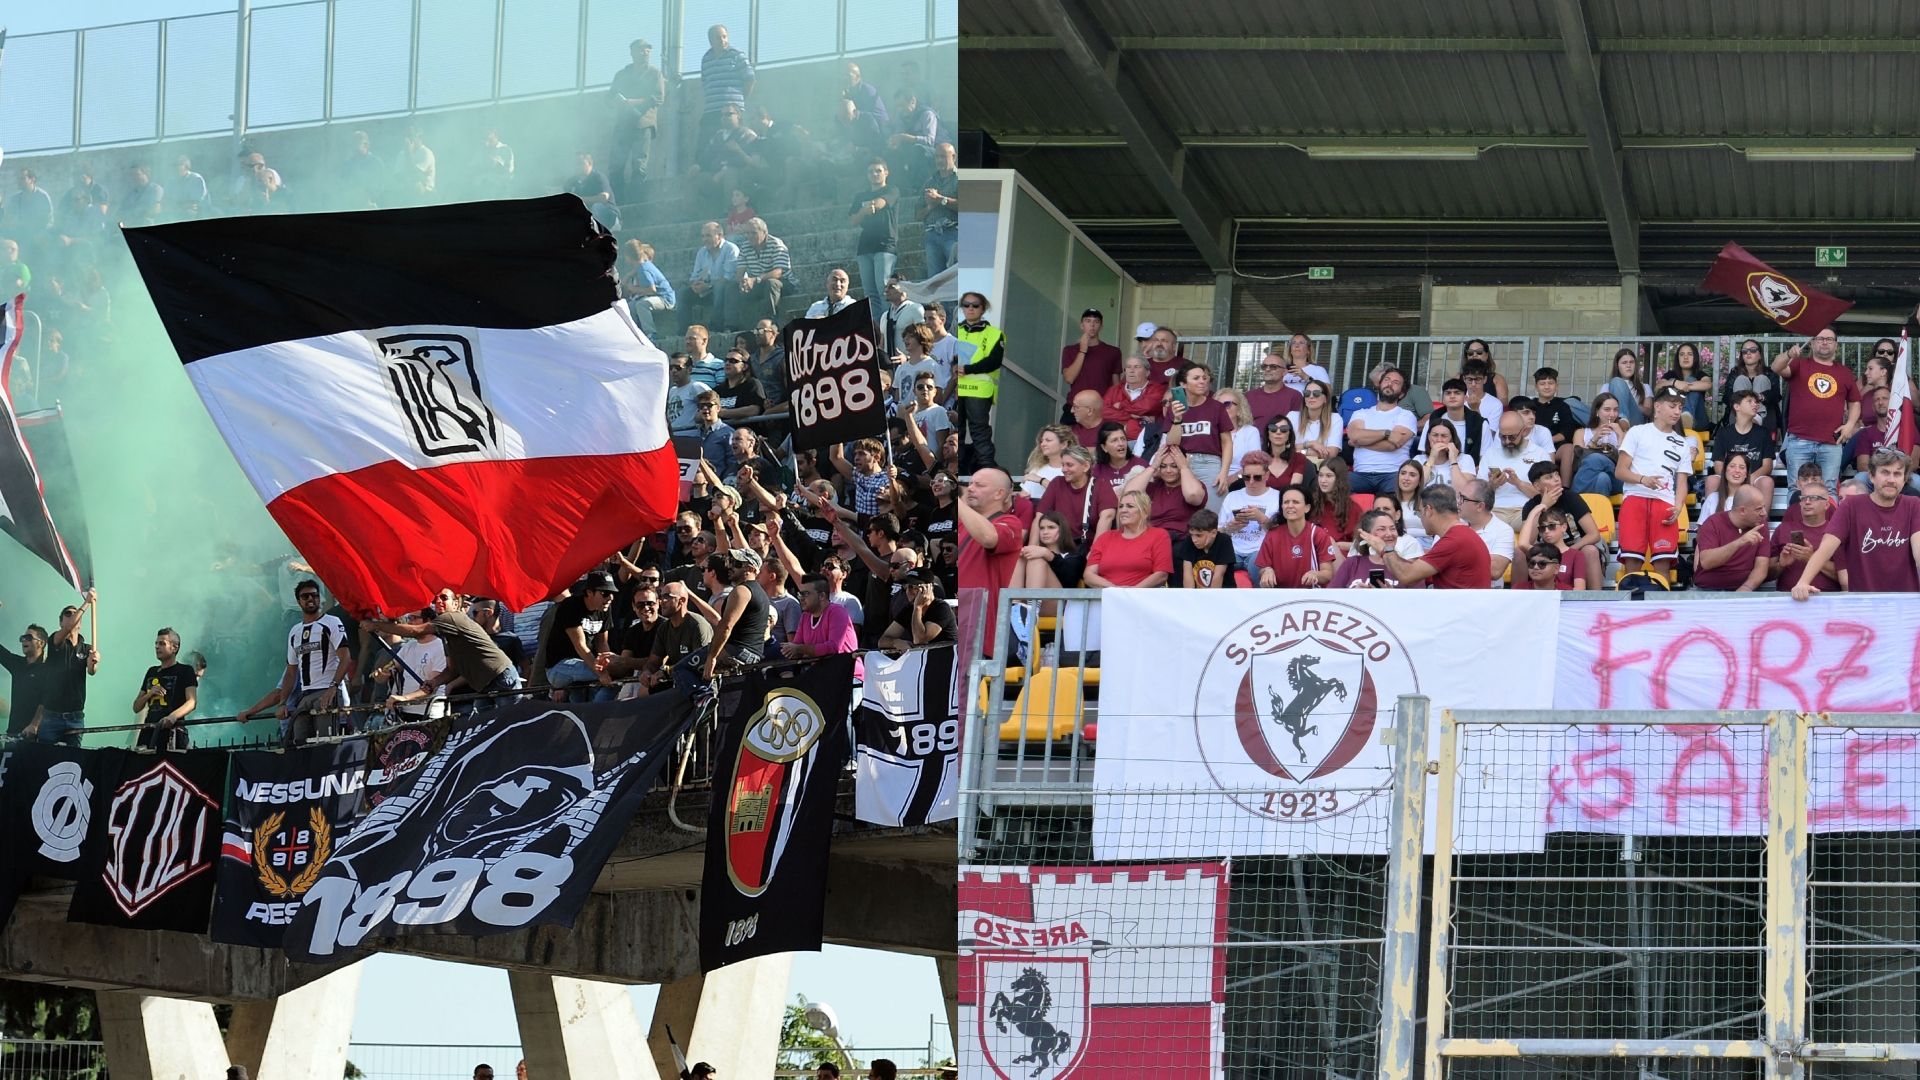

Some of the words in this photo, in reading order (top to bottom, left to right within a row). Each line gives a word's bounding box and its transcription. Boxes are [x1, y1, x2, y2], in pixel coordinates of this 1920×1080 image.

[791, 368, 875, 429] 1898
[1861, 528, 1909, 554] Babbo
[1588, 608, 1920, 738] FORZ
[235, 770, 365, 804] NESSUNA
[1259, 787, 1339, 818] 1923
[302, 851, 575, 955] 1898
